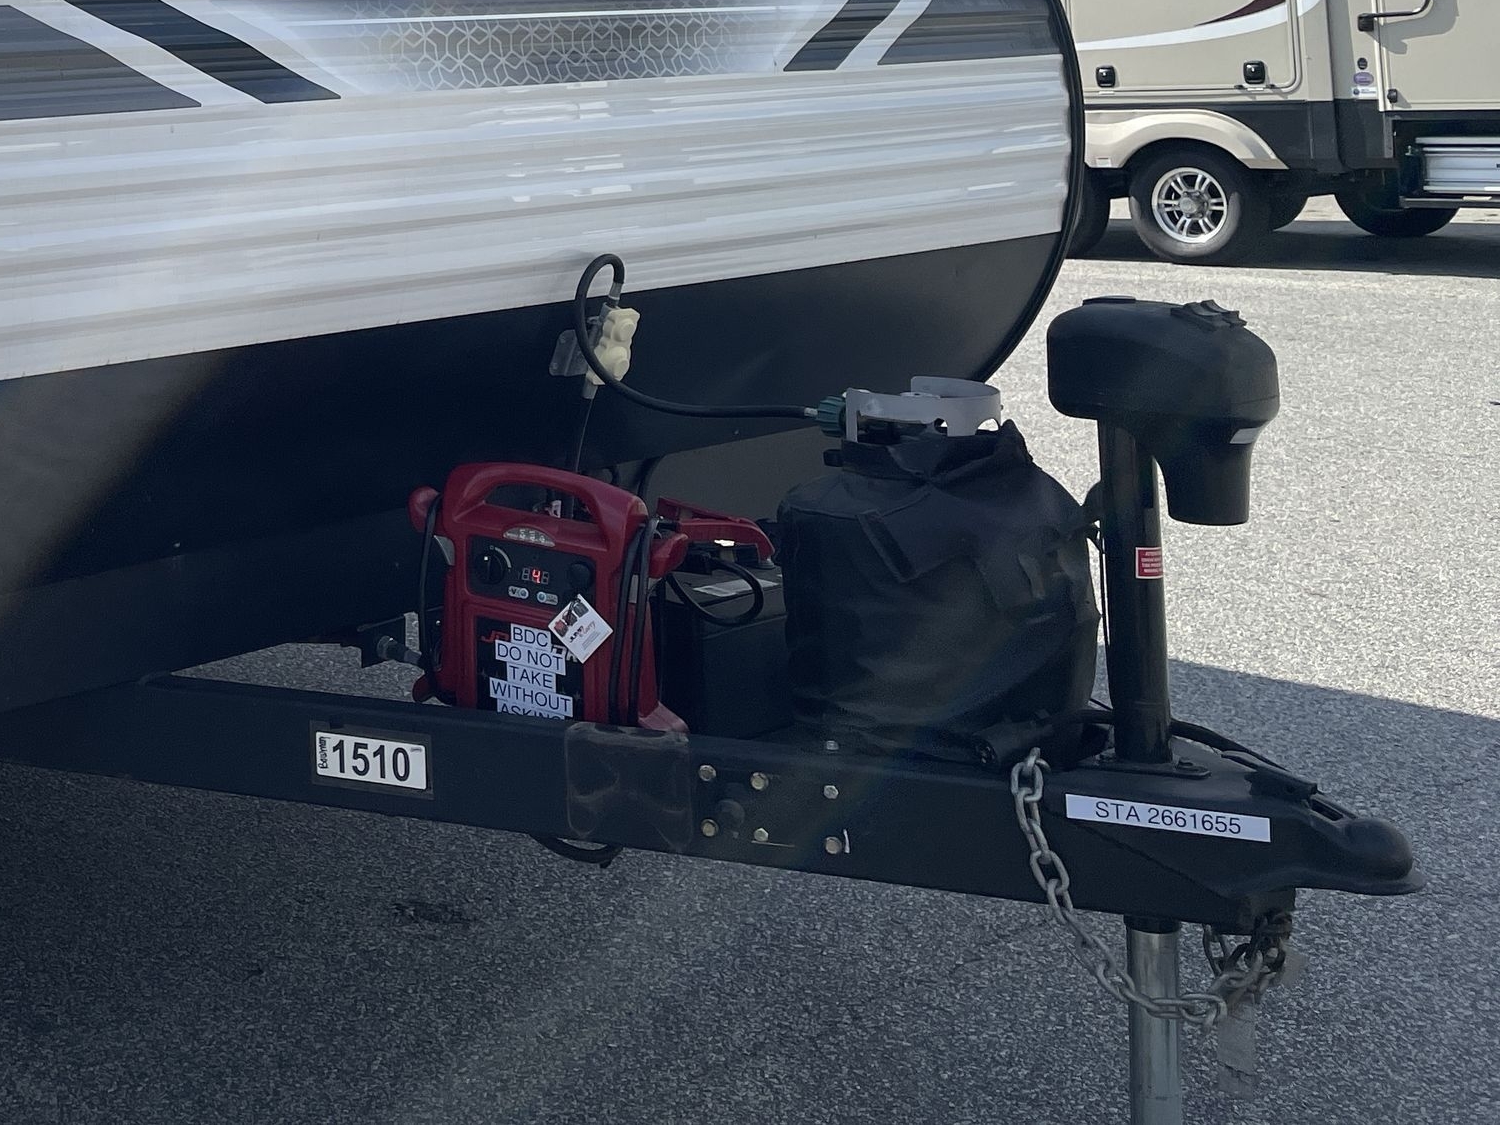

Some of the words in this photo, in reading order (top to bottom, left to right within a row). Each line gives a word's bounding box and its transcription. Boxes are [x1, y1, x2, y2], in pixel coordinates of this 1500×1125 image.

[512, 626, 549, 648] BDC
[497, 642, 522, 661] DO
[527, 650, 564, 671] NOT
[508, 665, 553, 689] TAKE
[491, 680, 571, 713] WITHOUT
[332, 739, 411, 782] 1510
[1095, 801, 1141, 823] STA
[1147, 807, 1242, 835] 2661655
